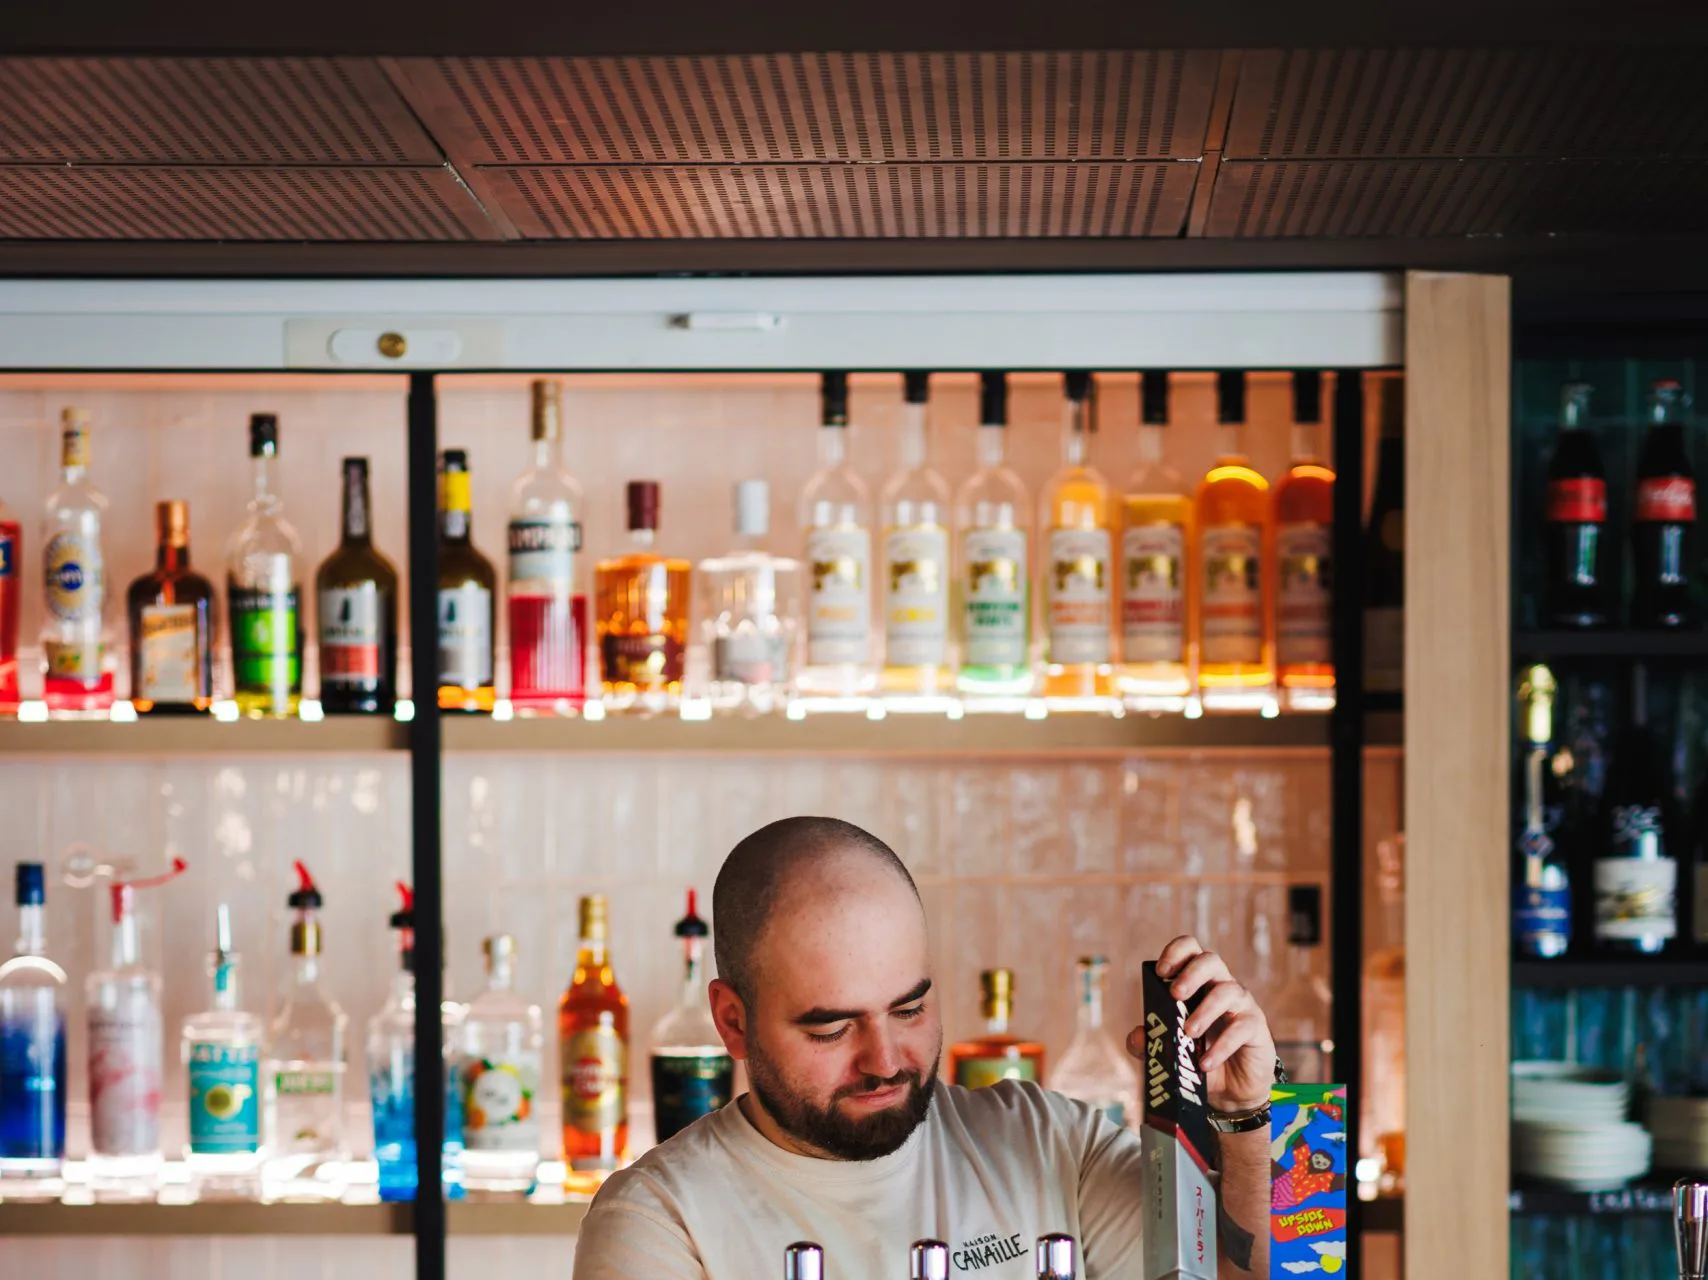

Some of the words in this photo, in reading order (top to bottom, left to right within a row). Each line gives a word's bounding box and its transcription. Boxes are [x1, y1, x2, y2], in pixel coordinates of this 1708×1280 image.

[1147, 1012, 1171, 1108] Asahi
[1278, 1208, 1325, 1227] UPSIDE
[1296, 1219, 1334, 1235] DOWN
[963, 1233, 997, 1247] MAISON
